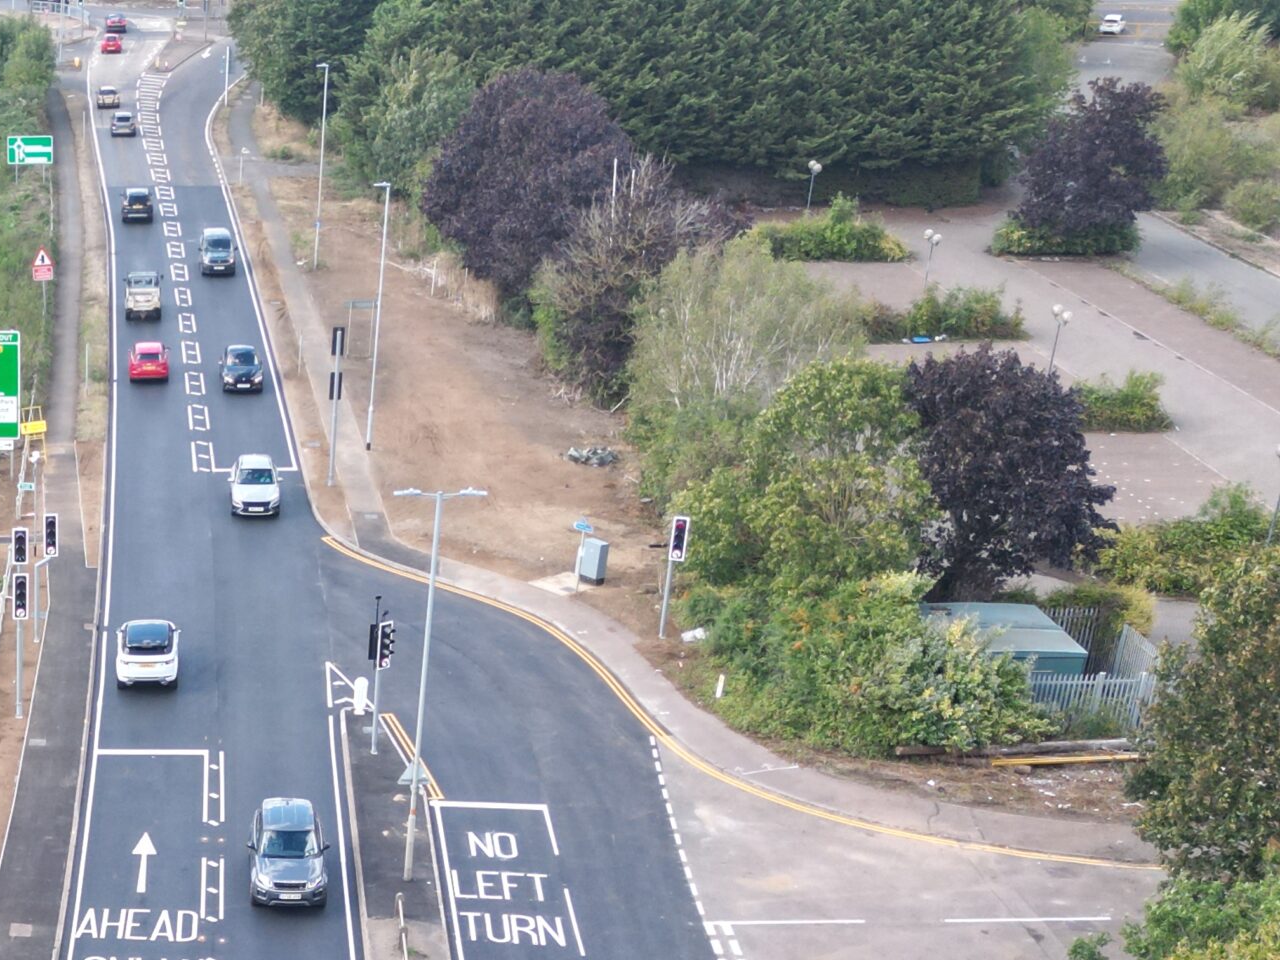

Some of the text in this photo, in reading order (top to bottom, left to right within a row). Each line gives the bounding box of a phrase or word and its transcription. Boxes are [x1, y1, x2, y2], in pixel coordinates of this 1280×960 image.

[467, 831, 519, 859] NO
[451, 869, 548, 902] LEFT
[74, 908, 199, 942] AHEAD
[459, 911, 567, 947] TURN
